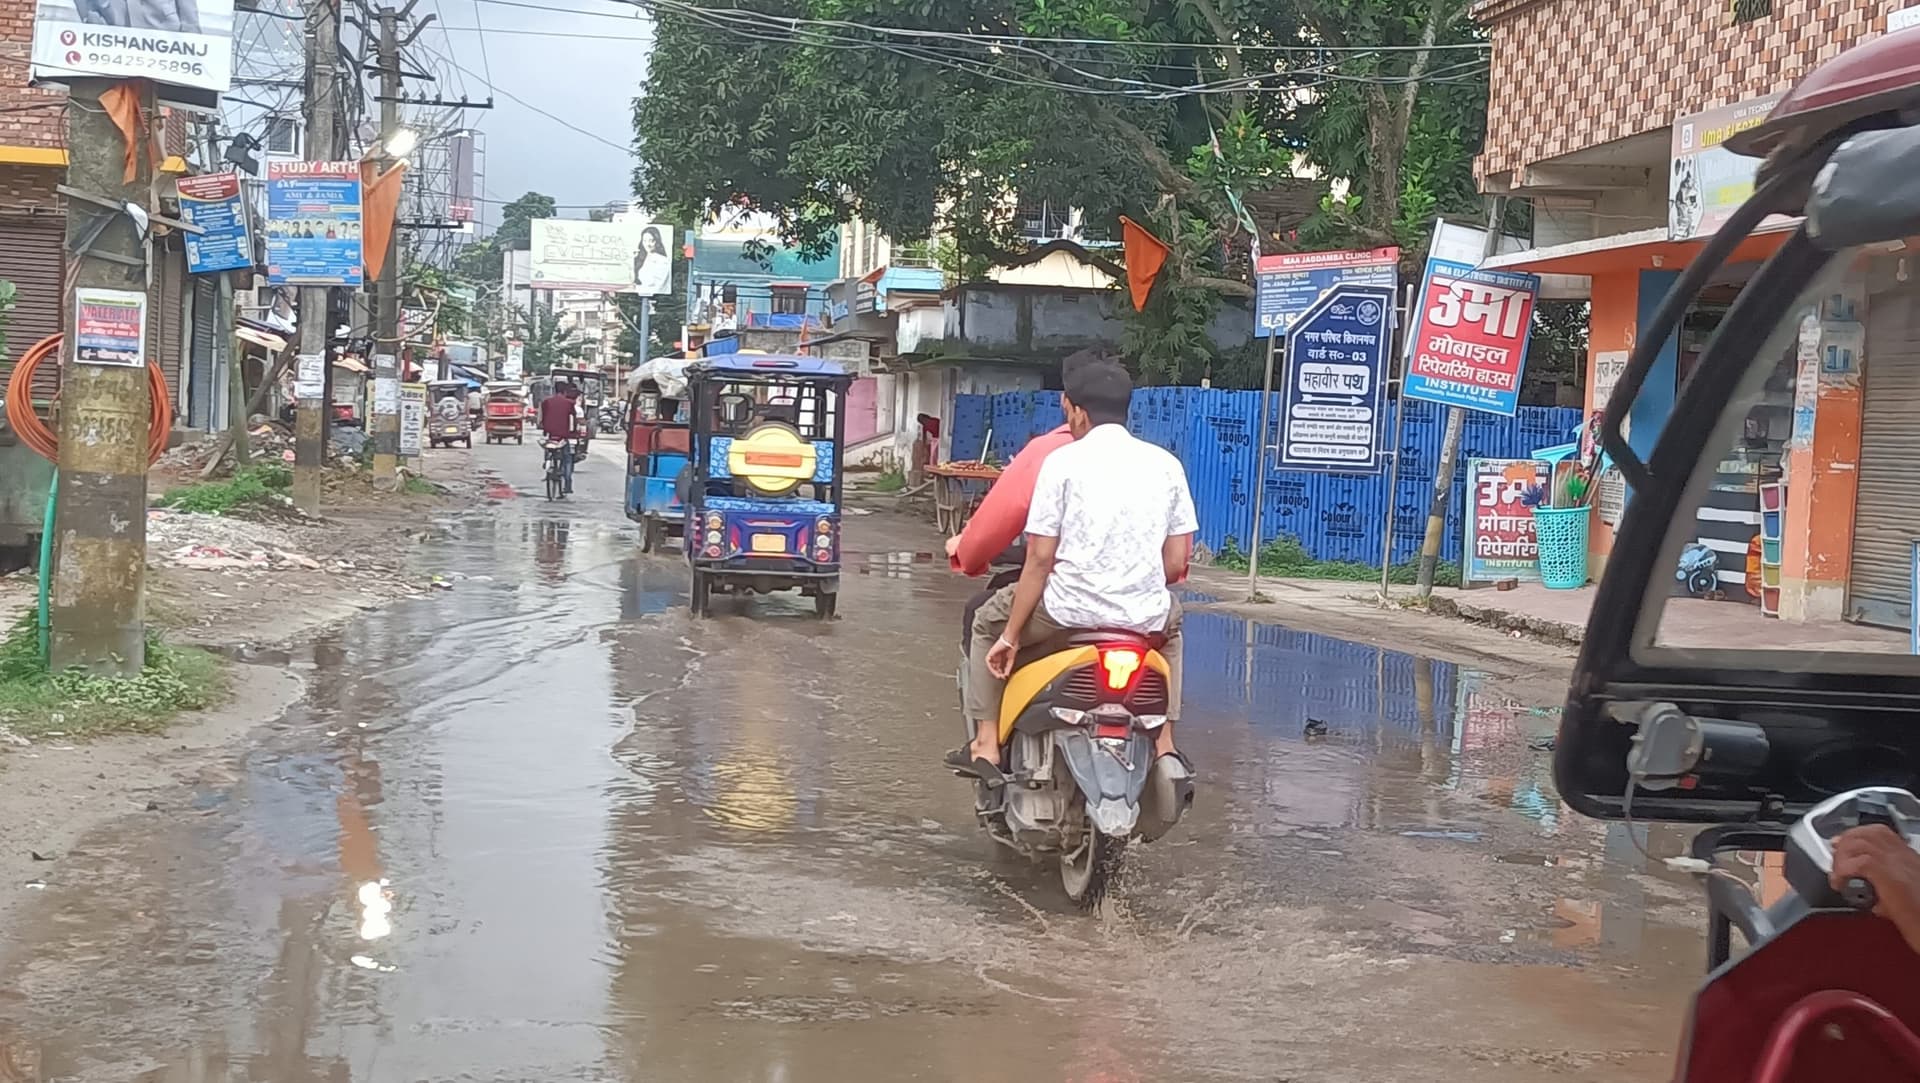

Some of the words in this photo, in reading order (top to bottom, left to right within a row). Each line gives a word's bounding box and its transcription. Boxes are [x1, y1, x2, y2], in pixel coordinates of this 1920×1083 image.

[82, 32, 209, 57] KISHANGANJ
[88, 53, 203, 76] 9942525896
[271, 161, 317, 174] STUDY
[320, 160, 359, 174] ARTH
[1283, 256, 1301, 265] MAA
[1301, 253, 1344, 264] JAGDAMBA
[1345, 251, 1372, 261] CLINIC
[1428, 276, 1531, 338] उमा
[1303, 331, 1320, 343] नगर
[1320, 328, 1342, 345] परिषद
[1343, 330, 1377, 346] किशनगंज
[1307, 346, 1328, 360] वार्ड
[1428, 333, 1510, 365] मोबाइल
[1303, 366, 1340, 390] महावीर
[1342, 373, 1366, 391] पथ
[1418, 353, 1474, 381] रिपेयरिंग
[1475, 367, 1512, 388] हाउस
[1424, 377, 1498, 400] INSTITUTE
[1485, 558, 1535, 569] INSTITUTE
